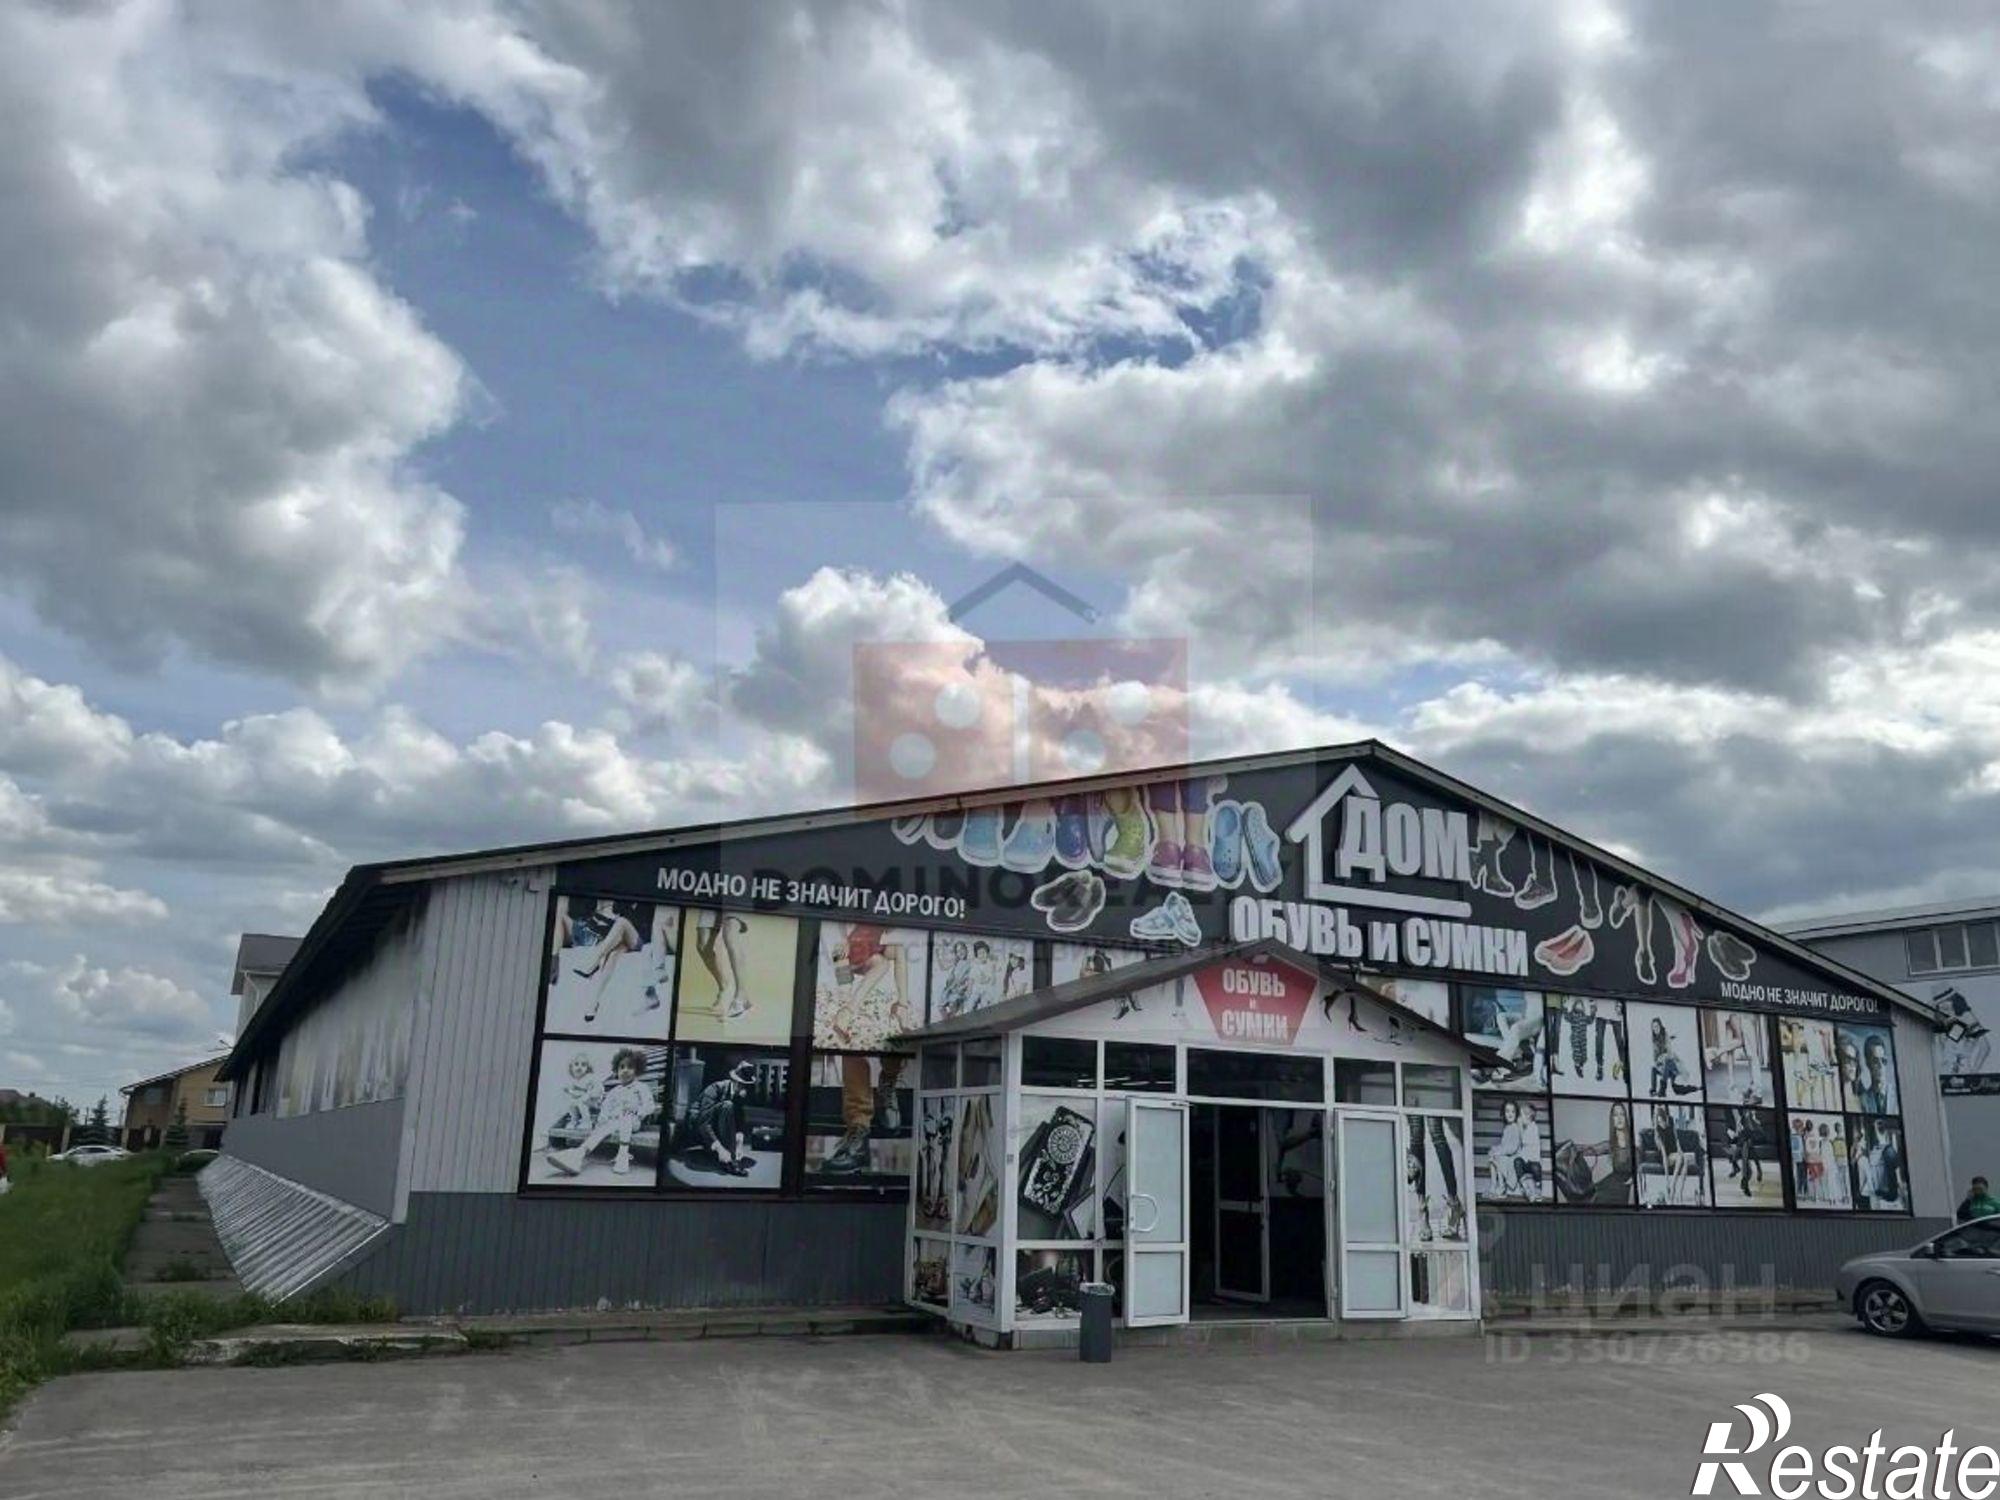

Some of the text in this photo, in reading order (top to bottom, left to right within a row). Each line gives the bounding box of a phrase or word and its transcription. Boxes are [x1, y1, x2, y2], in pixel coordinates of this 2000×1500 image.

[1335, 794, 1473, 883] ДОМ
[656, 867, 966, 919] МОДНО НЕ ЗНАЧИТ ДОРОГО!
[1229, 895, 1364, 958] ОБУВЬ
[1403, 917, 1529, 977] СУМКИ
[1222, 968, 1286, 998] ОБУВЬ
[1720, 982, 1879, 1014] МОДНО НЕ ЗНАЧИТ ДОРОГО!
[1221, 1009, 1288, 1040] СУМКИ
